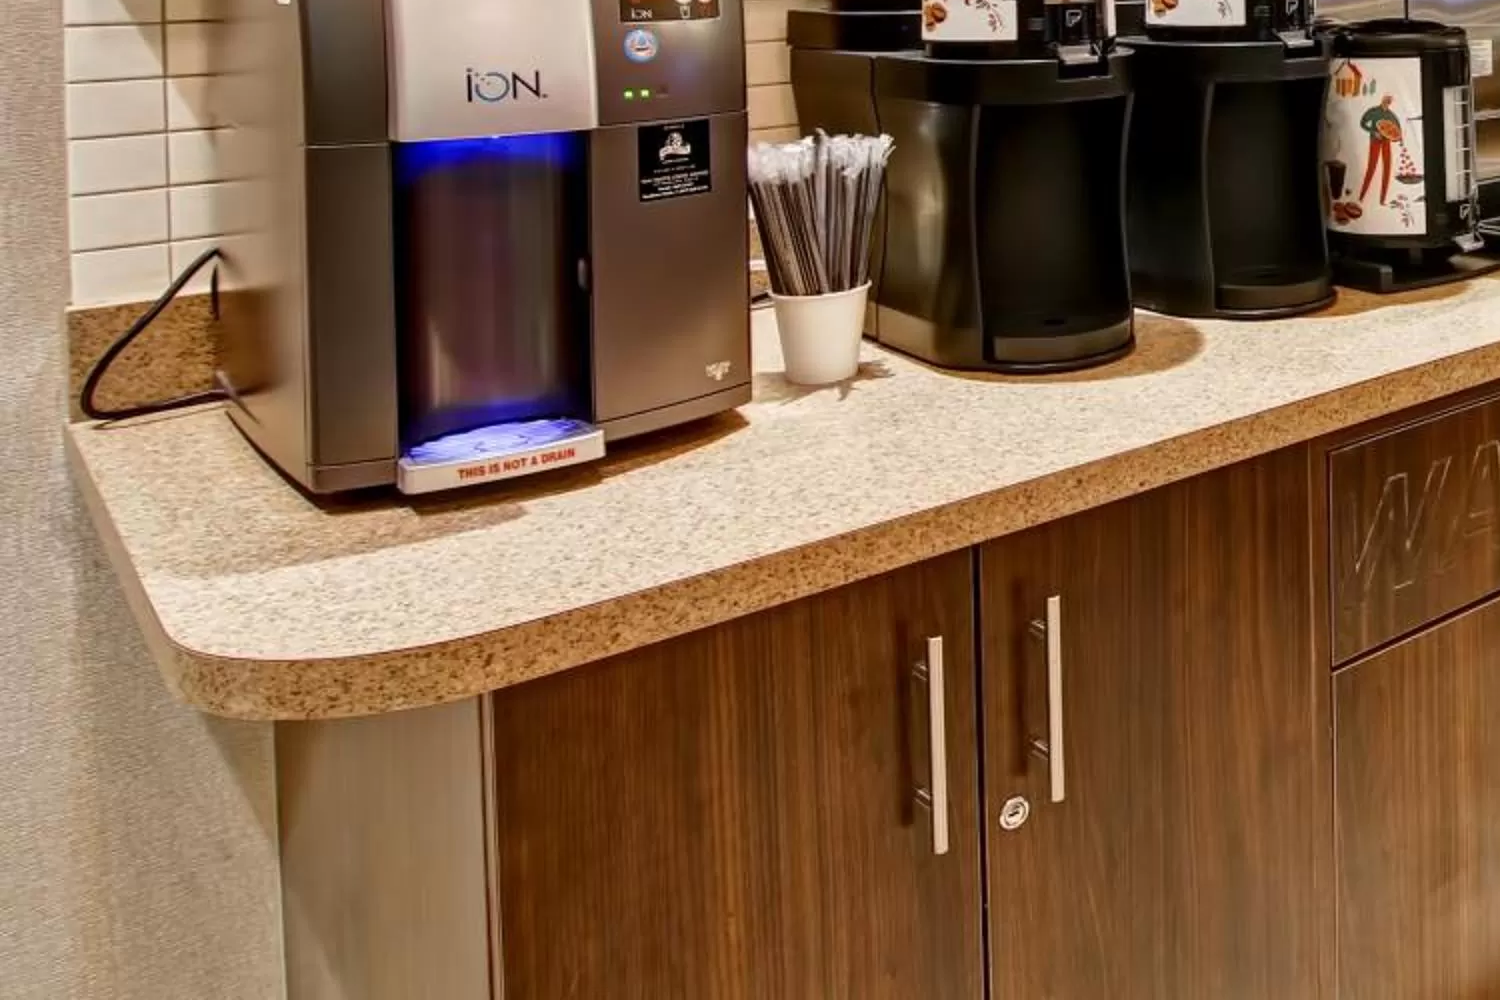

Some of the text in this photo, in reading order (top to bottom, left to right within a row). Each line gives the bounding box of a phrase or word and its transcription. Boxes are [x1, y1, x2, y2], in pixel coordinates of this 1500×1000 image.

[457, 447, 576, 479] THIS IS NOT A DRAIN
